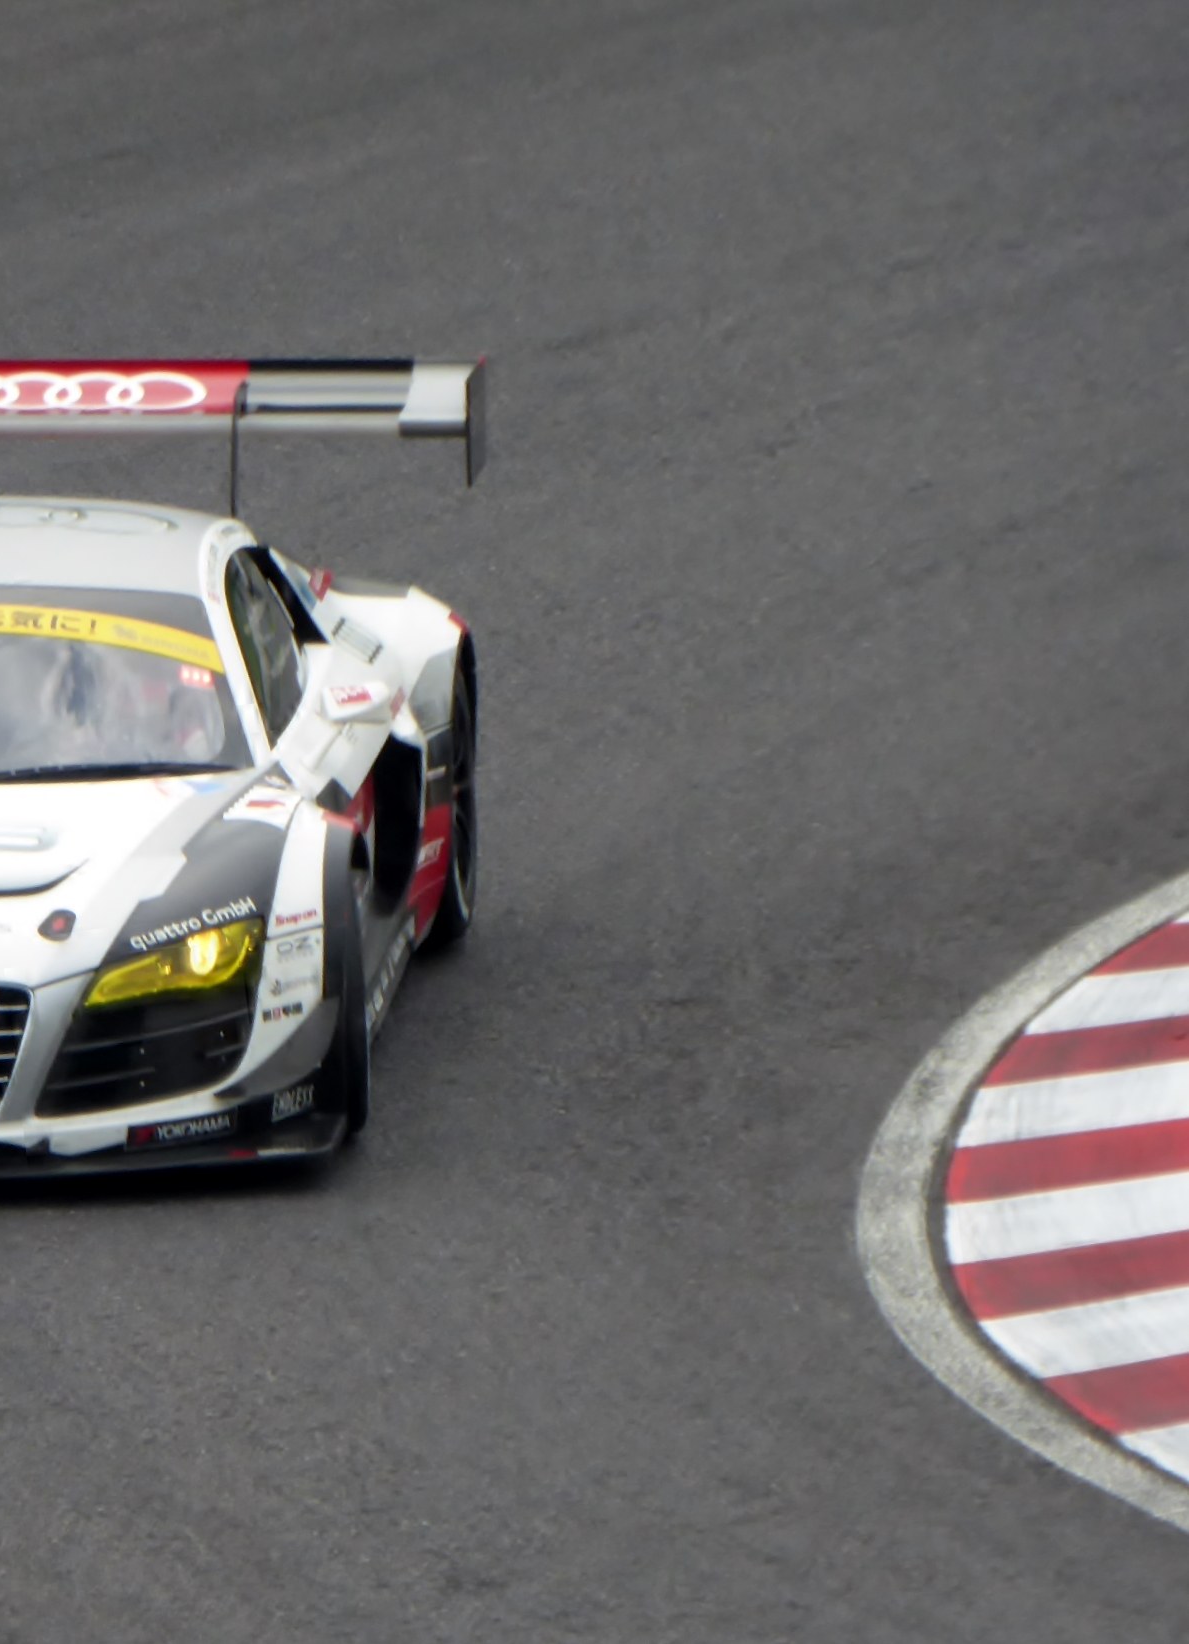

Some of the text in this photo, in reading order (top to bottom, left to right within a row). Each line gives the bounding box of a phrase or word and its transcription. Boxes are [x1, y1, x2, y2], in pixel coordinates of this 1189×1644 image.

[130, 896, 258, 951] quattro GmbH
[156, 1114, 231, 1141] YOKOHAMA
